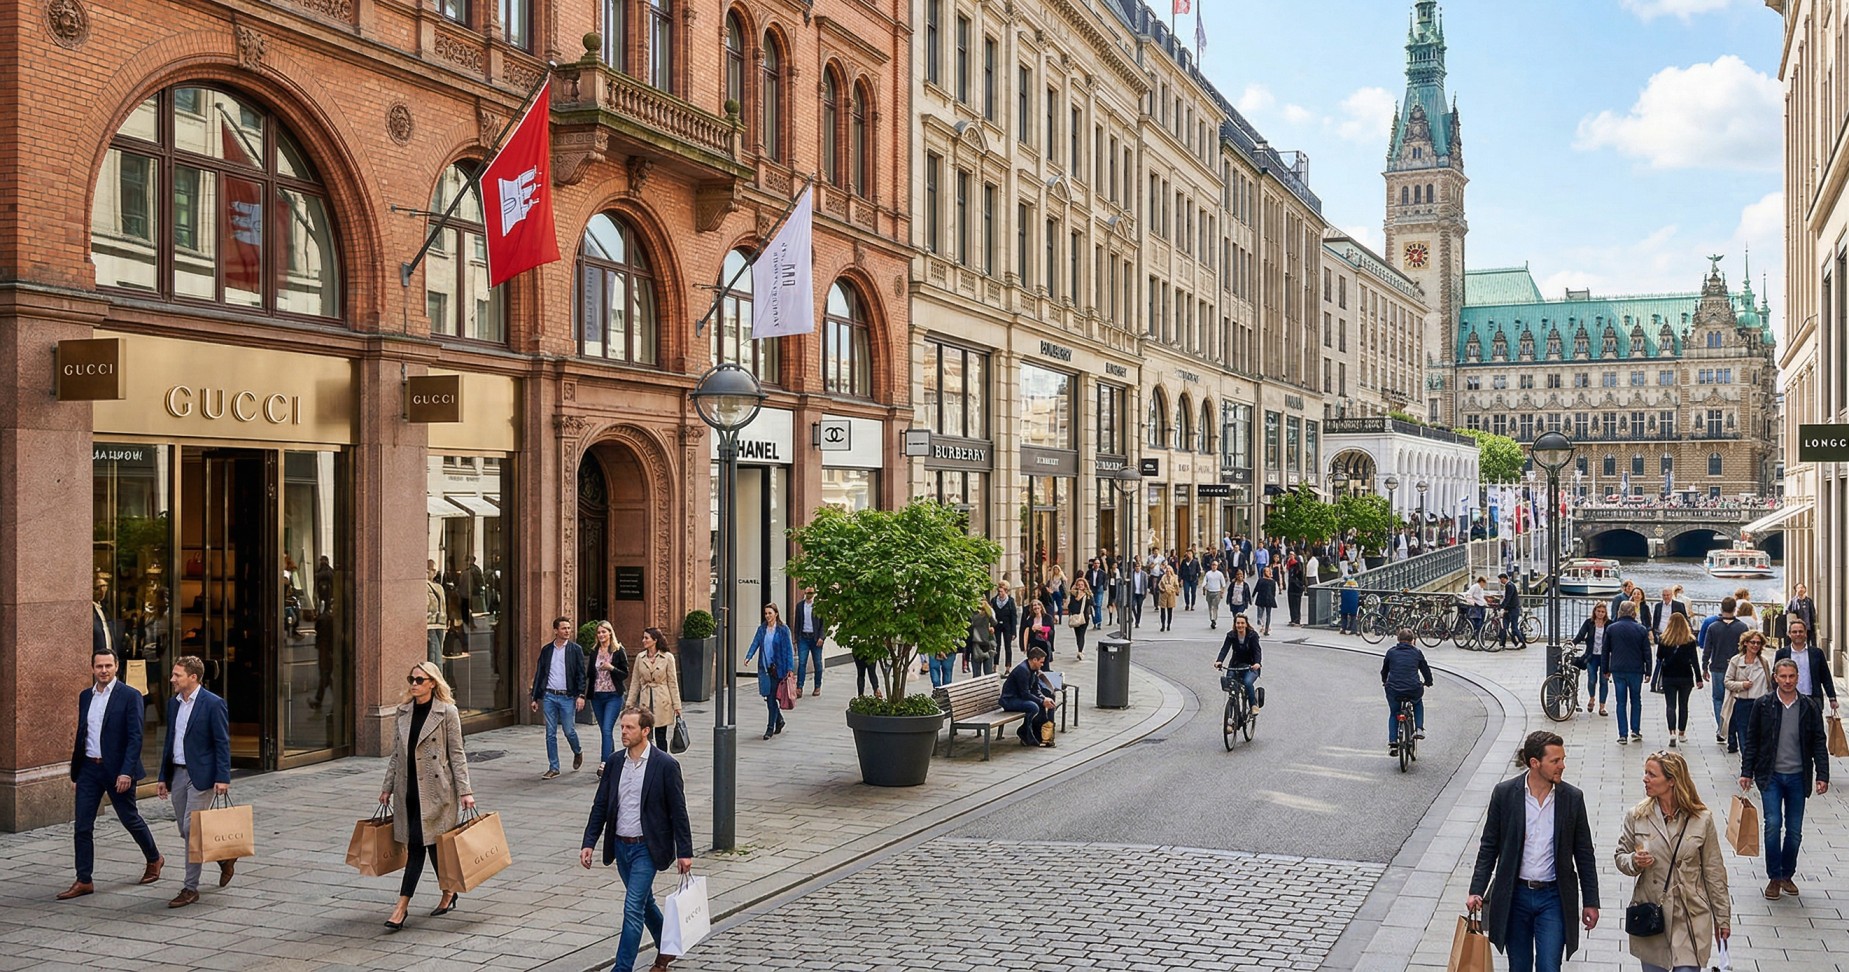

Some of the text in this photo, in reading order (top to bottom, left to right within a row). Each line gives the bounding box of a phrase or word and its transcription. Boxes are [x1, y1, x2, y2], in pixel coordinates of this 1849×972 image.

[64, 363, 113, 376] GUCCI
[165, 385, 301, 425] GUCCI
[413, 394, 455, 405] GUCCI
[736, 440, 780, 460] HANEL
[1804, 438, 1847, 448] LONGC
[933, 444, 986, 462] BURBERRY
[214, 832, 244, 842] GUCCI
[474, 845, 499, 865] GUCCI
